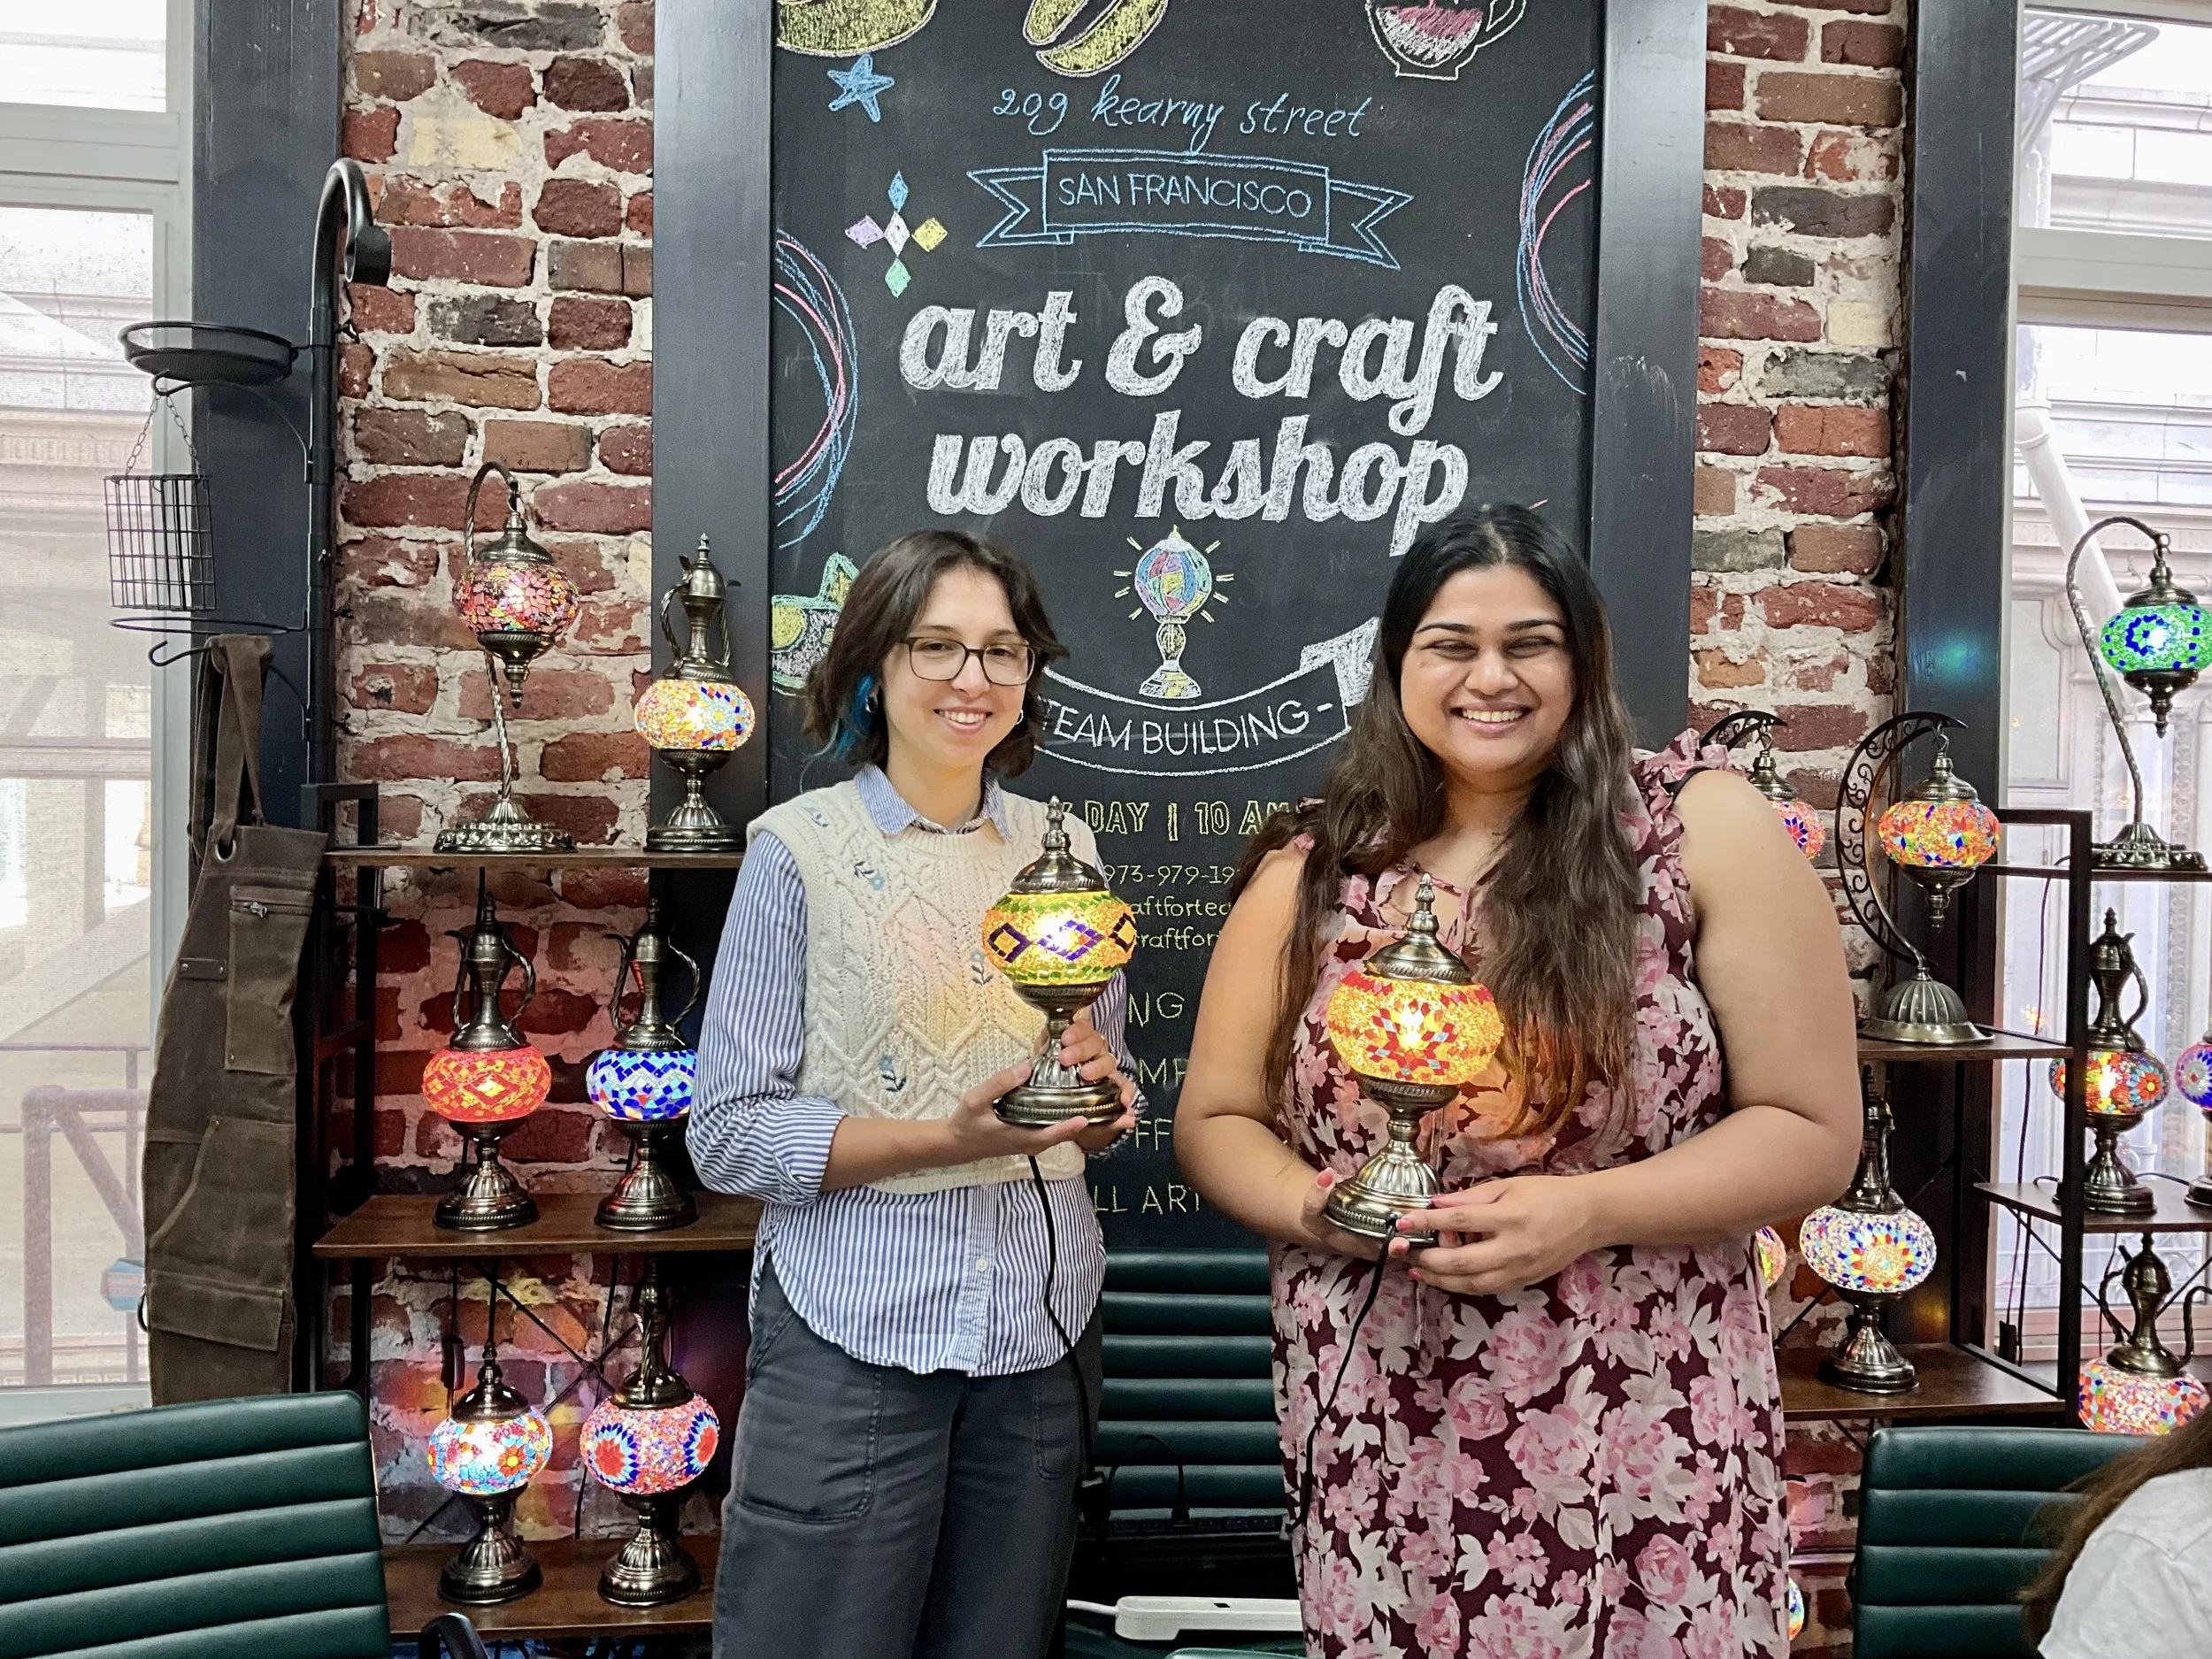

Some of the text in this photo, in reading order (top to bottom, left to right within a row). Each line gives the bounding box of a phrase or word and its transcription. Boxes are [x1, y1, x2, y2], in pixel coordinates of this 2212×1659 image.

[993, 74, 1371, 152] 209 kearny street
[1058, 173, 1312, 219] SAN FRANCISCO
[899, 291, 1083, 392] art
[1105, 275, 1202, 396] &
[1232, 284, 1504, 436] craft
[926, 410, 1469, 557] workshop
[1141, 700, 1310, 757] BUILDING
[1085, 800, 1149, 834] DAY
[1195, 801, 1230, 834] 10
[1104, 864, 1240, 886] 973-979-19
[1135, 926, 1221, 949] raftfor
